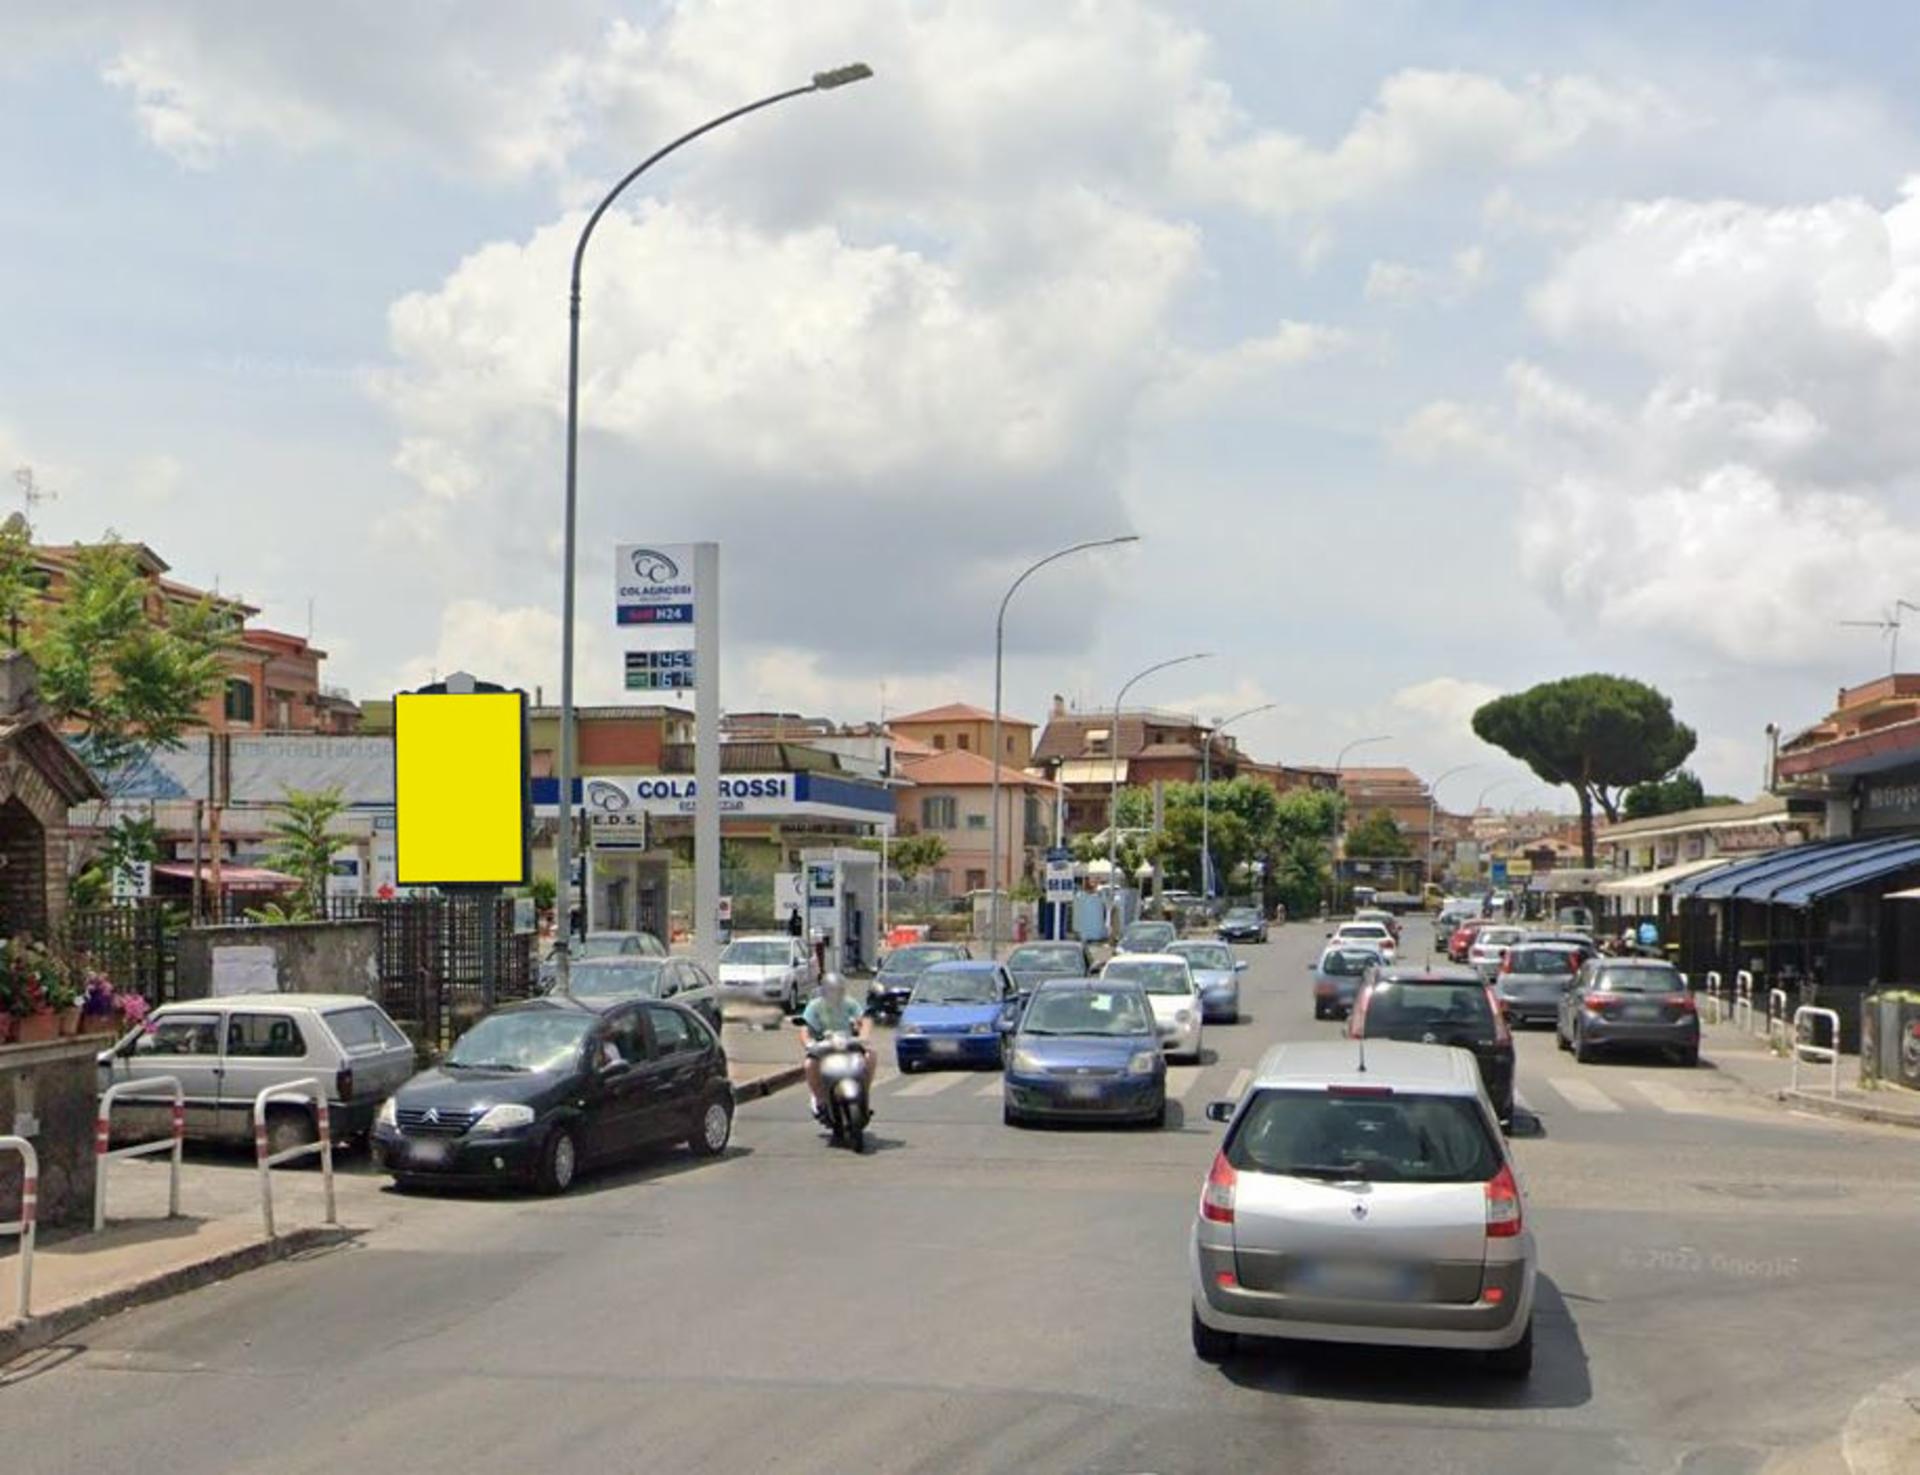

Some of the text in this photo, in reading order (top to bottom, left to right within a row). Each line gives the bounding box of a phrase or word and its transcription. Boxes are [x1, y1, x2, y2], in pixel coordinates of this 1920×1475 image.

[620, 586, 692, 597] COLAGROSSI
[656, 608, 682, 620] H24
[637, 779, 786, 799] COLAROSSI
